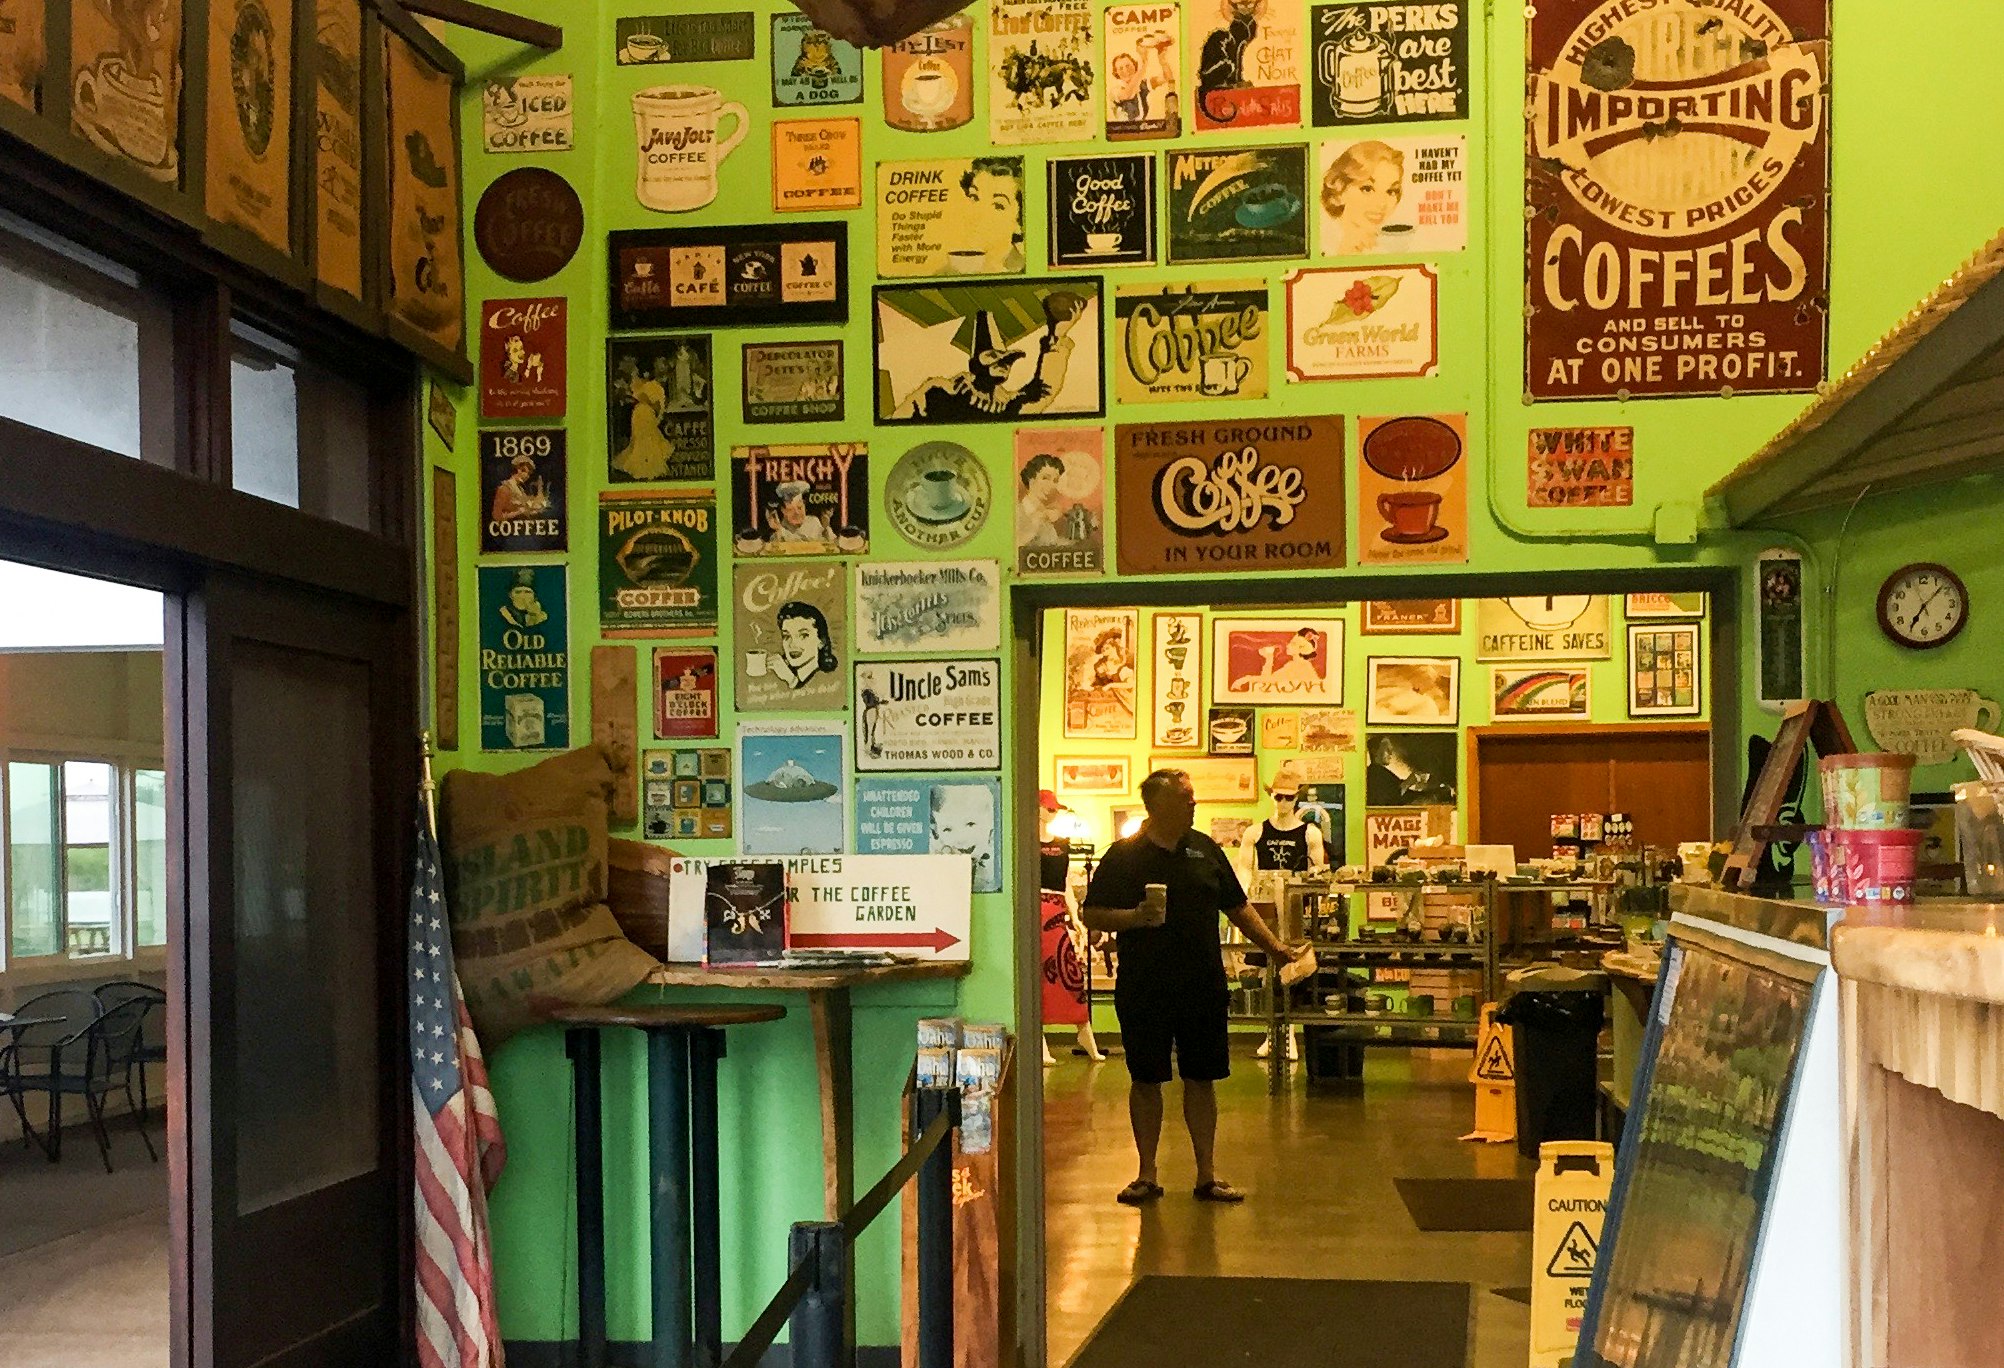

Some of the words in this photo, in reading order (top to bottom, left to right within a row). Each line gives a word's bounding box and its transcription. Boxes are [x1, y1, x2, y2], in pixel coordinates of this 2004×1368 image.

[1321, 8, 1366, 35] The
[1370, 4, 1458, 32] PERKS
[1565, 0, 1670, 66] HIGHES
[1400, 36, 1452, 58] are
[1258, 65, 1298, 81] NOIR
[1395, 61, 1457, 91] best
[521, 95, 567, 113] ICED
[796, 91, 805, 100] A
[809, 90, 840, 100] DOG
[1395, 91, 1456, 115] HERE
[1548, 67, 1815, 149] IMPORTING
[489, 129, 568, 148] COFFEE
[648, 152, 707, 164] COFFEE
[1415, 149, 1420, 159] I
[1422, 147, 1459, 159] HAVEN'T
[1419, 161, 1438, 171] HAD
[1440, 160, 1455, 170] MY
[890, 170, 943, 186] DRINK
[1076, 174, 1124, 193] Good
[1412, 171, 1445, 184] COFFEE
[1447, 171, 1462, 182] YET
[784, 187, 855, 199] COFFEE
[885, 188, 949, 205] COFFEE
[1199, 179, 1250, 215] COFFEE
[1570, 167, 1676, 230] LOWEST
[1686, 156, 1783, 228] PRICES
[892, 212, 907, 221] Do
[909, 210, 943, 222] Stupid
[1072, 196, 1131, 224] Coffee
[892, 221, 926, 233] Things
[892, 232, 924, 242] Faster
[891, 243, 914, 252] with
[916, 242, 942, 252] More
[892, 254, 929, 265] Energy
[1543, 206, 1807, 312] COFFEES
[488, 303, 559, 334] Coffee
[1603, 318, 1646, 333] AND
[1654, 316, 1704, 331] SELL
[1716, 315, 1744, 328] TO
[1361, 322, 1420, 343] World
[1335, 344, 1389, 359] FARMS
[1576, 331, 1766, 354] CONSUMERS
[1547, 358, 1584, 385] AT
[1601, 355, 1663, 382] ONE
[1677, 351, 1802, 380] PROFIT.
[750, 403, 799, 417] COFFEE
[1131, 425, 1205, 448] FRESH
[1214, 424, 1314, 445] GROUND
[1534, 430, 1631, 454] WHITE
[493, 437, 552, 457] 1869
[1531, 457, 1633, 484] SWAN
[809, 492, 838, 504] COFFEE
[1158, 446, 1307, 534] Coffee
[1531, 485, 1629, 503] COFFEE
[489, 519, 559, 536] COFFEE
[892, 498, 961, 545] ANOTHER
[1027, 551, 1095, 569] COFFEE
[1165, 547, 1187, 562] IN
[1195, 545, 1260, 561] YOUR
[1265, 542, 1332, 559] ROOM
[619, 592, 698, 606] COFFEE
[503, 629, 545, 650] OLD
[1483, 634, 1554, 652] CAFFEINE
[1563, 633, 1604, 650] SAVES
[482, 650, 567, 671] RELIABLE
[487, 671, 563, 689] COFFEE
[889, 671, 942, 702] Uncle
[945, 665, 991, 691] Sam's
[915, 711, 994, 727] COFFEE
[885, 750, 928, 760] THOMAS
[932, 749, 963, 759] WOOD
[871, 807, 913, 817] CHILDREN
[861, 823, 881, 834] WILL
[883, 823, 894, 834] BE
[896, 822, 923, 834] GIVEN
[871, 839, 913, 850] ESPRESSO
[811, 886, 843, 902] THE
[851, 886, 911, 902] COFFEE
[855, 906, 916, 921] GARDEN
[1548, 1199, 1608, 1212] CAUTION
[1564, 1299, 1587, 1309] FLO
